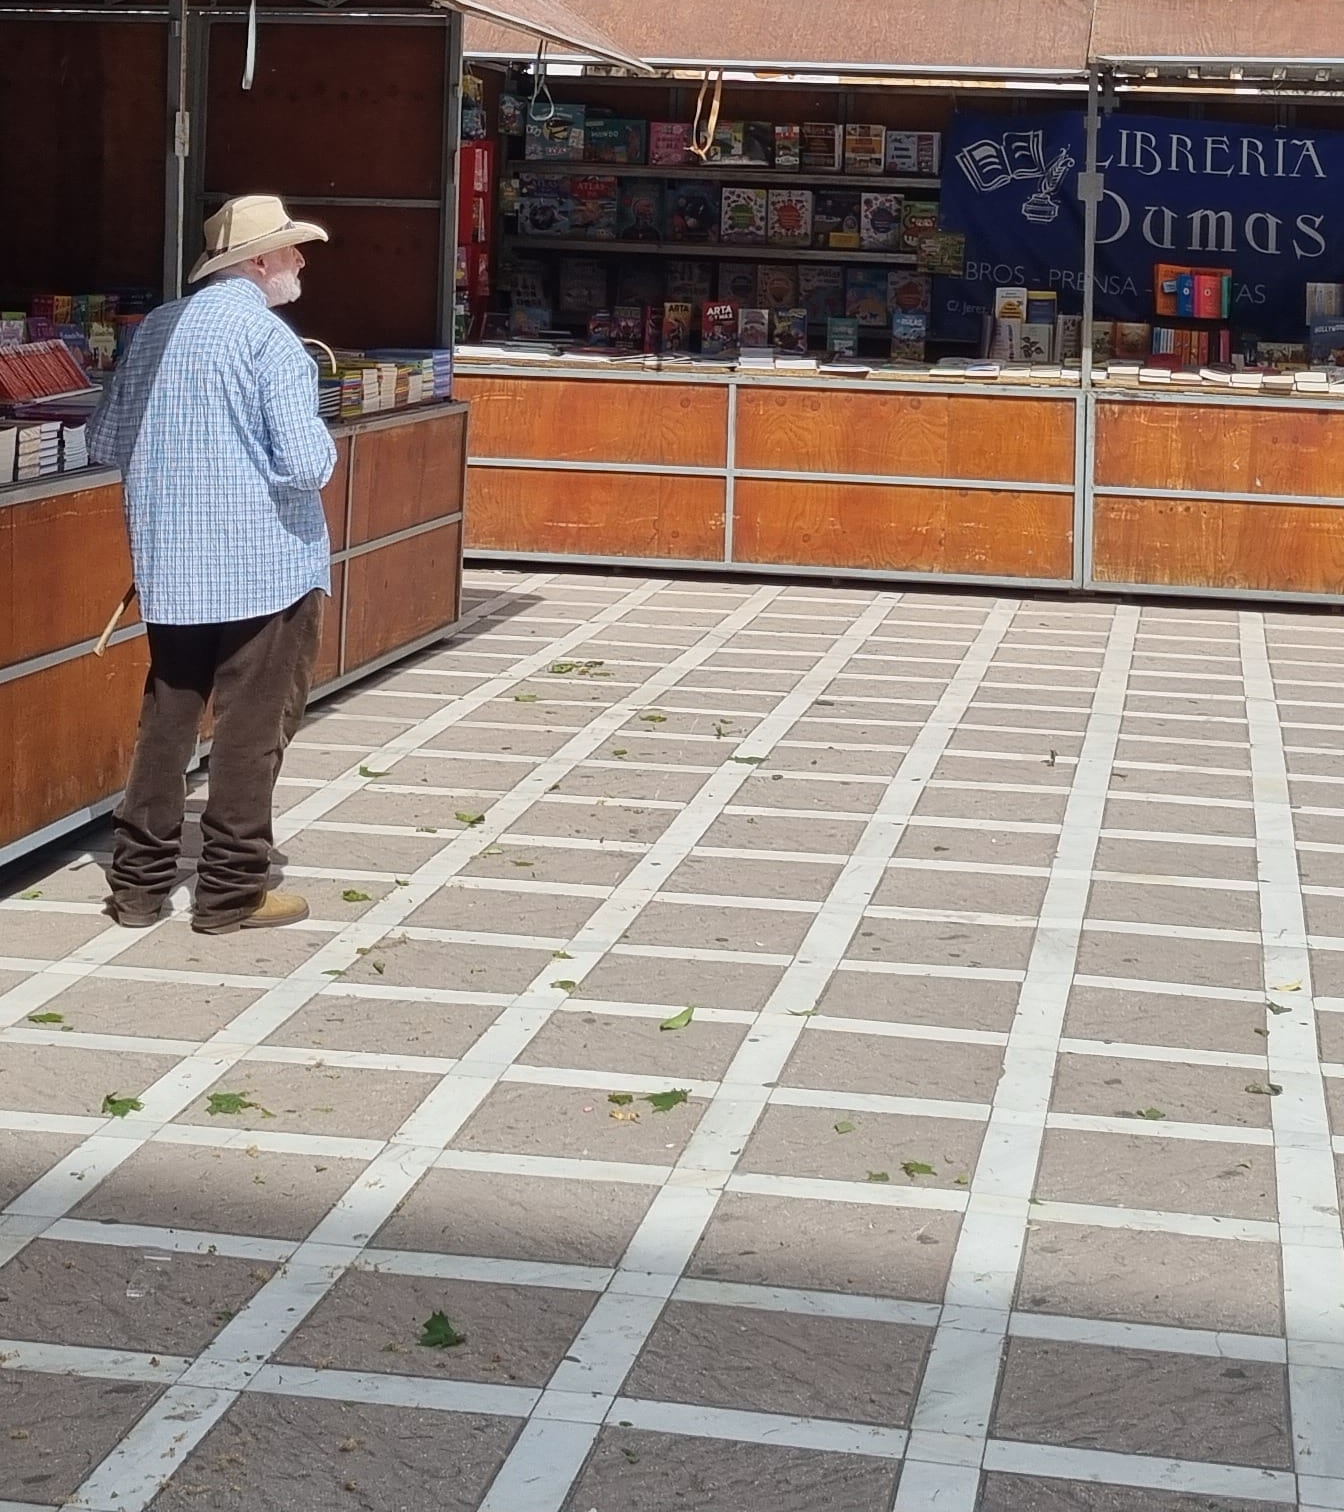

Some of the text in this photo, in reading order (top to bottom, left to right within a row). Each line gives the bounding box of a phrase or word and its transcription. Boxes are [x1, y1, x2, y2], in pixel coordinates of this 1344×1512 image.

[576, 181, 605, 190] ATLAS
[1093, 188, 1327, 262] Dumas
[1048, 268, 1138, 297] PRENSA
[668, 304, 689, 313] ARTA
[706, 304, 732, 316] ARTA
